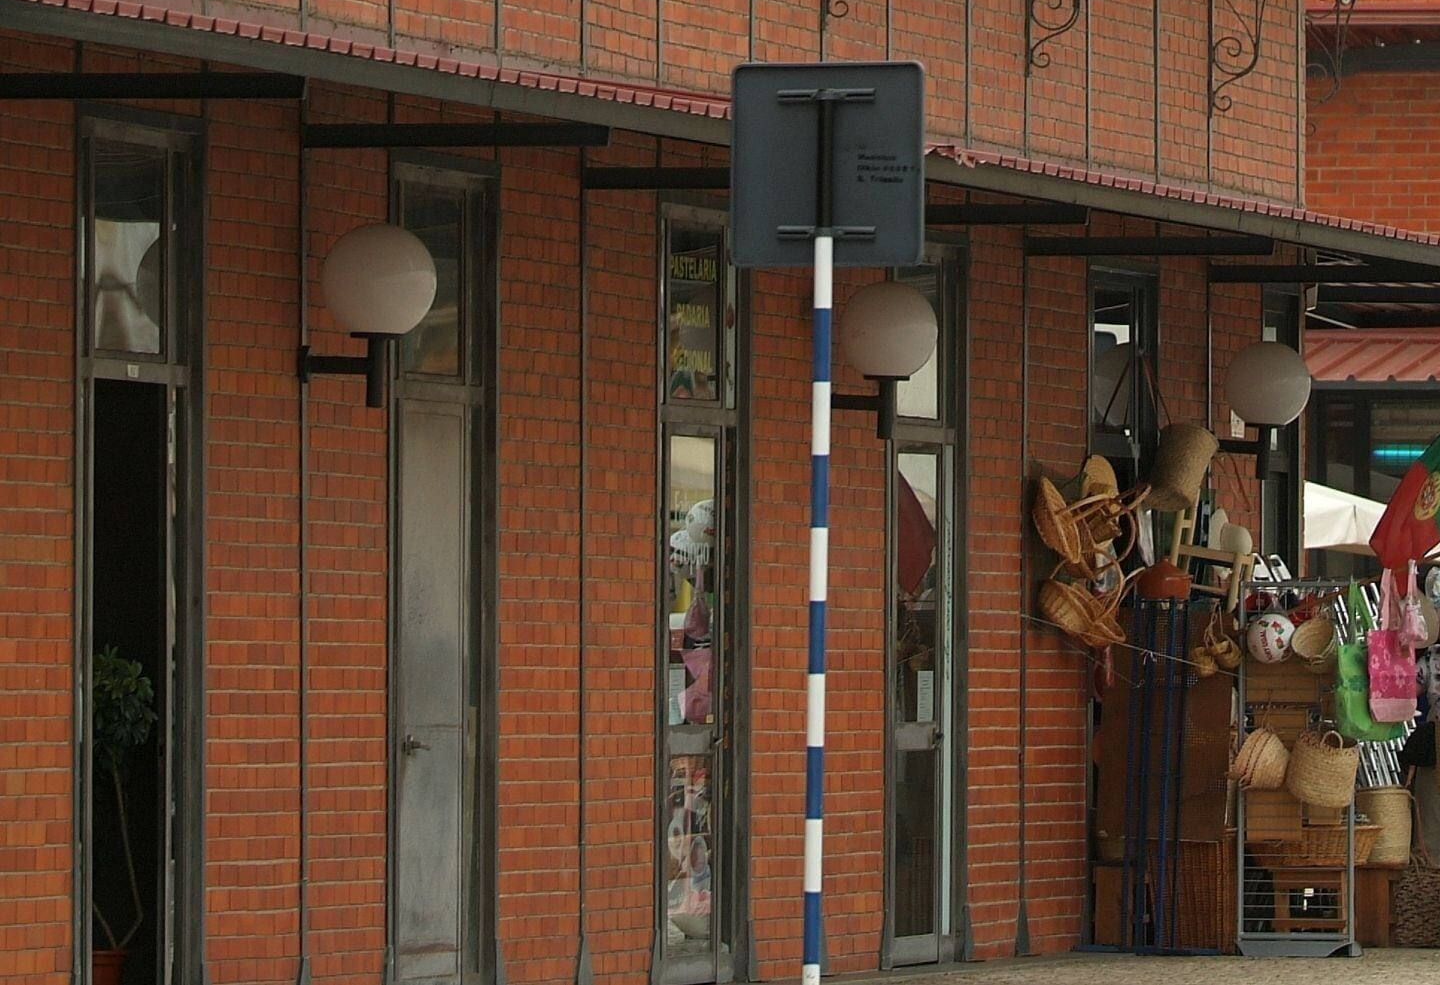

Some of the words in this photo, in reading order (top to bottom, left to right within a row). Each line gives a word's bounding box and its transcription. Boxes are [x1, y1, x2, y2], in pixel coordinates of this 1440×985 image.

[670, 256, 717, 282] PASTELARIA
[676, 303, 710, 328] PADARIA
[672, 348, 713, 373] REGIONAL
